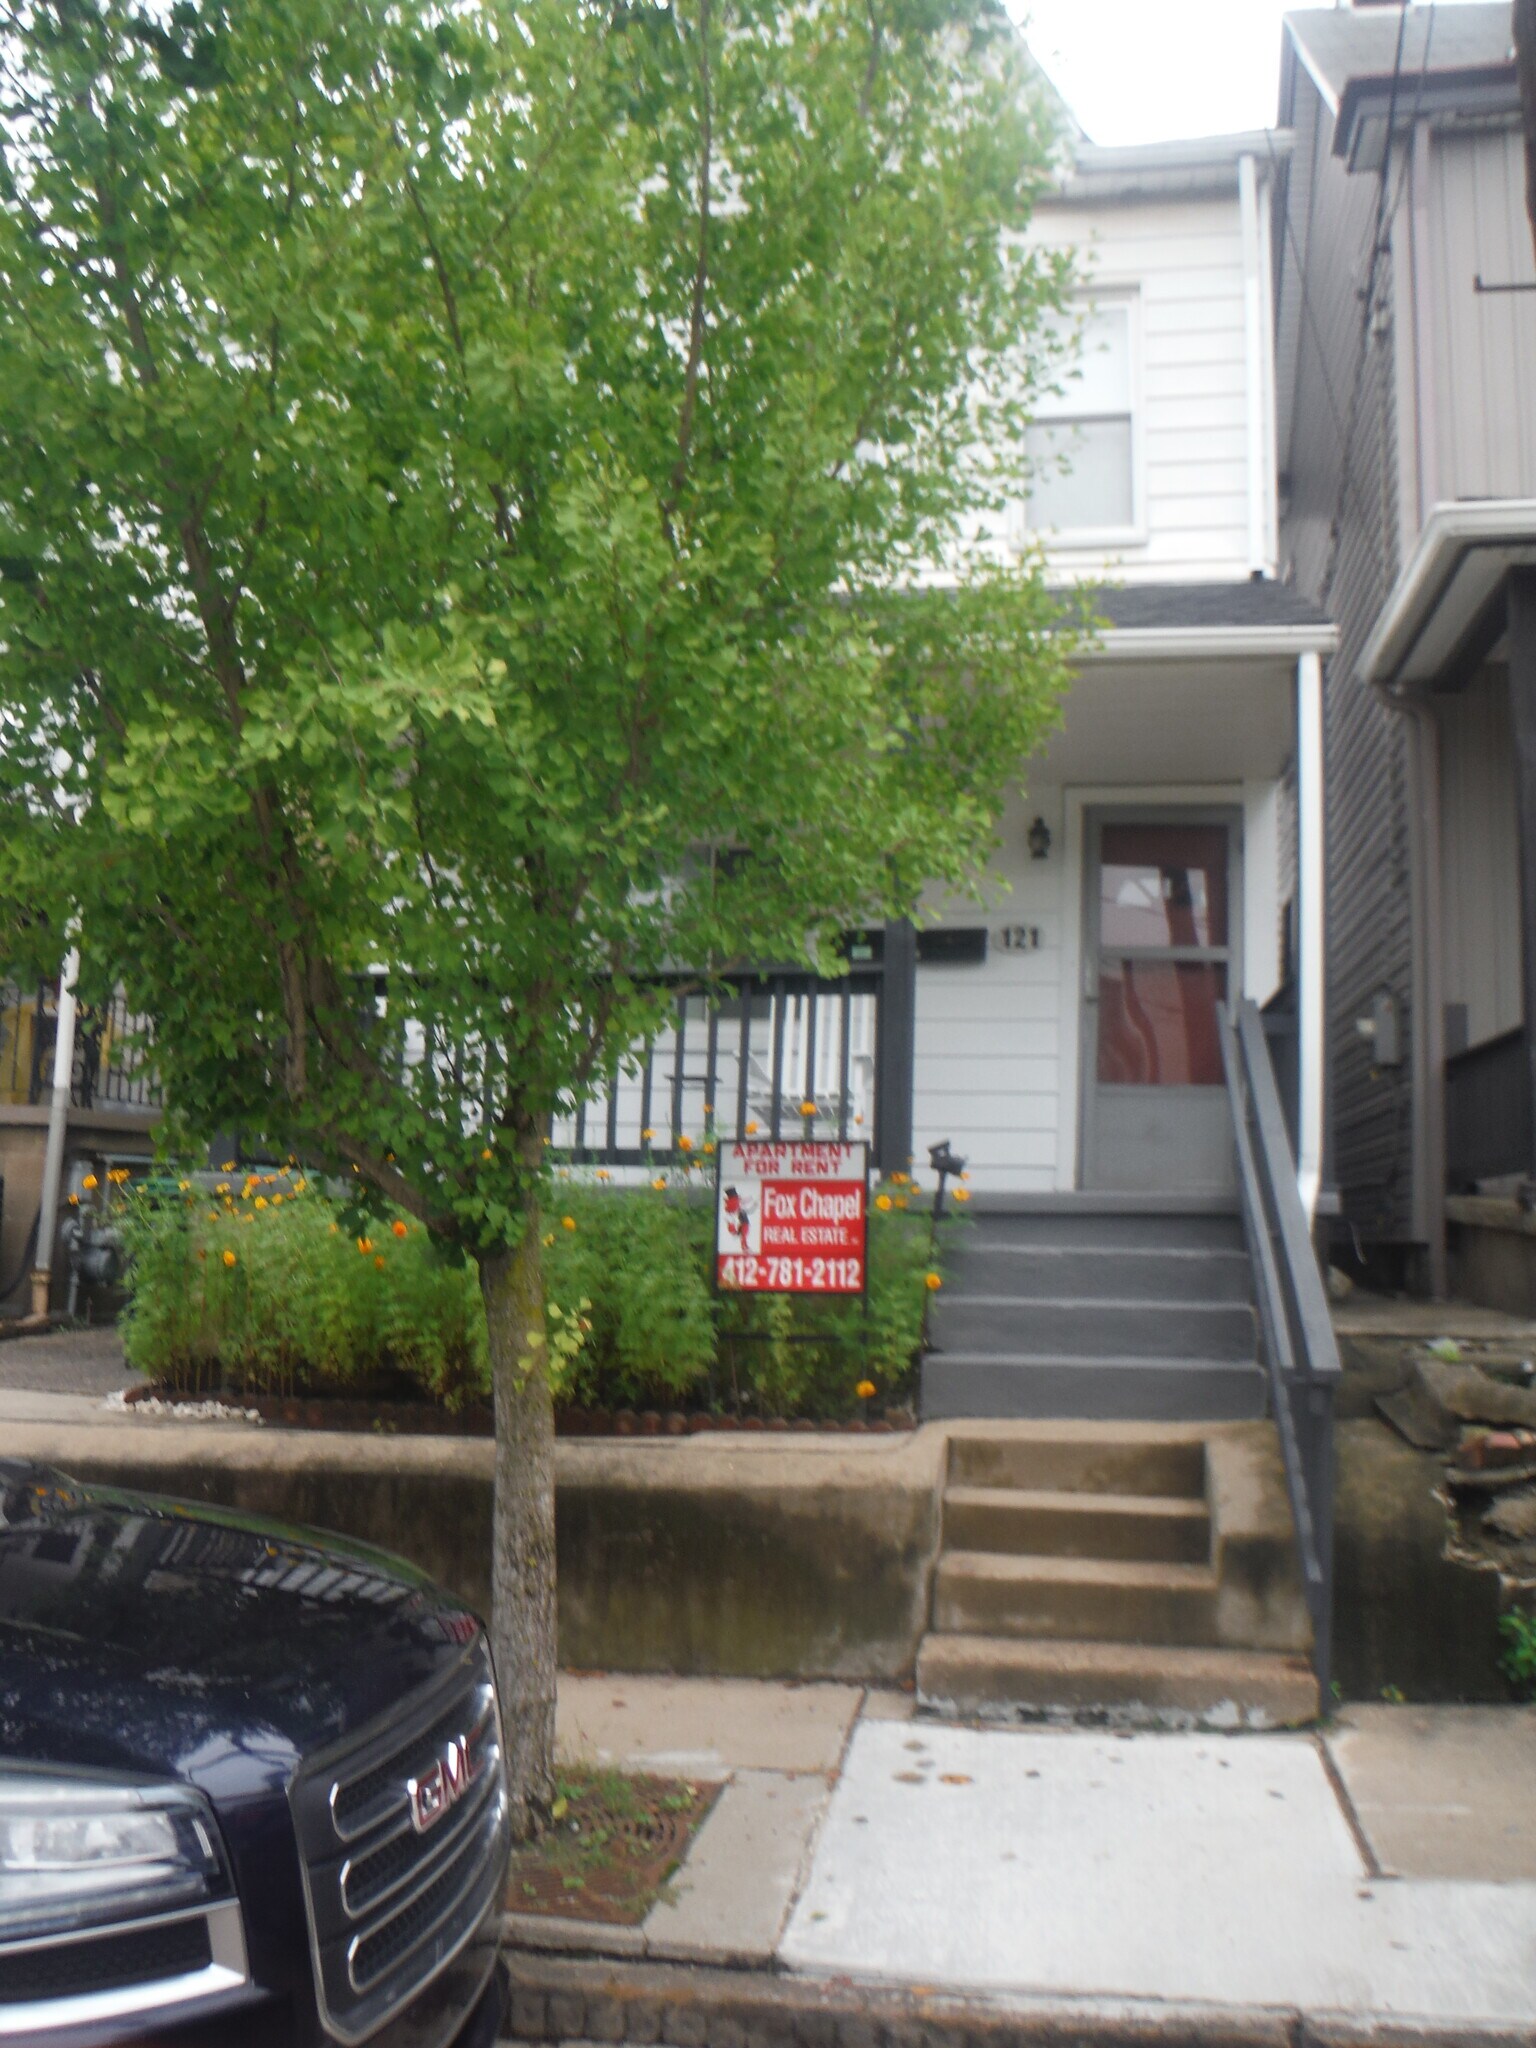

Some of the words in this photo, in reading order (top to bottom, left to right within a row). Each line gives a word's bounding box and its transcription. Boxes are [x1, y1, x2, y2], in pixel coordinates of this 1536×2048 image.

[1002, 926, 1040, 949] 121
[732, 1142, 853, 1158] APARTMENT
[743, 1159, 780, 1174] FOR
[790, 1159, 841, 1174] RENT
[764, 1187, 798, 1219] Fox
[800, 1187, 861, 1225] Chapel
[763, 1226, 798, 1244] REAL
[801, 1226, 849, 1245] ESTATE
[722, 1256, 861, 1288] 412-781-2112
